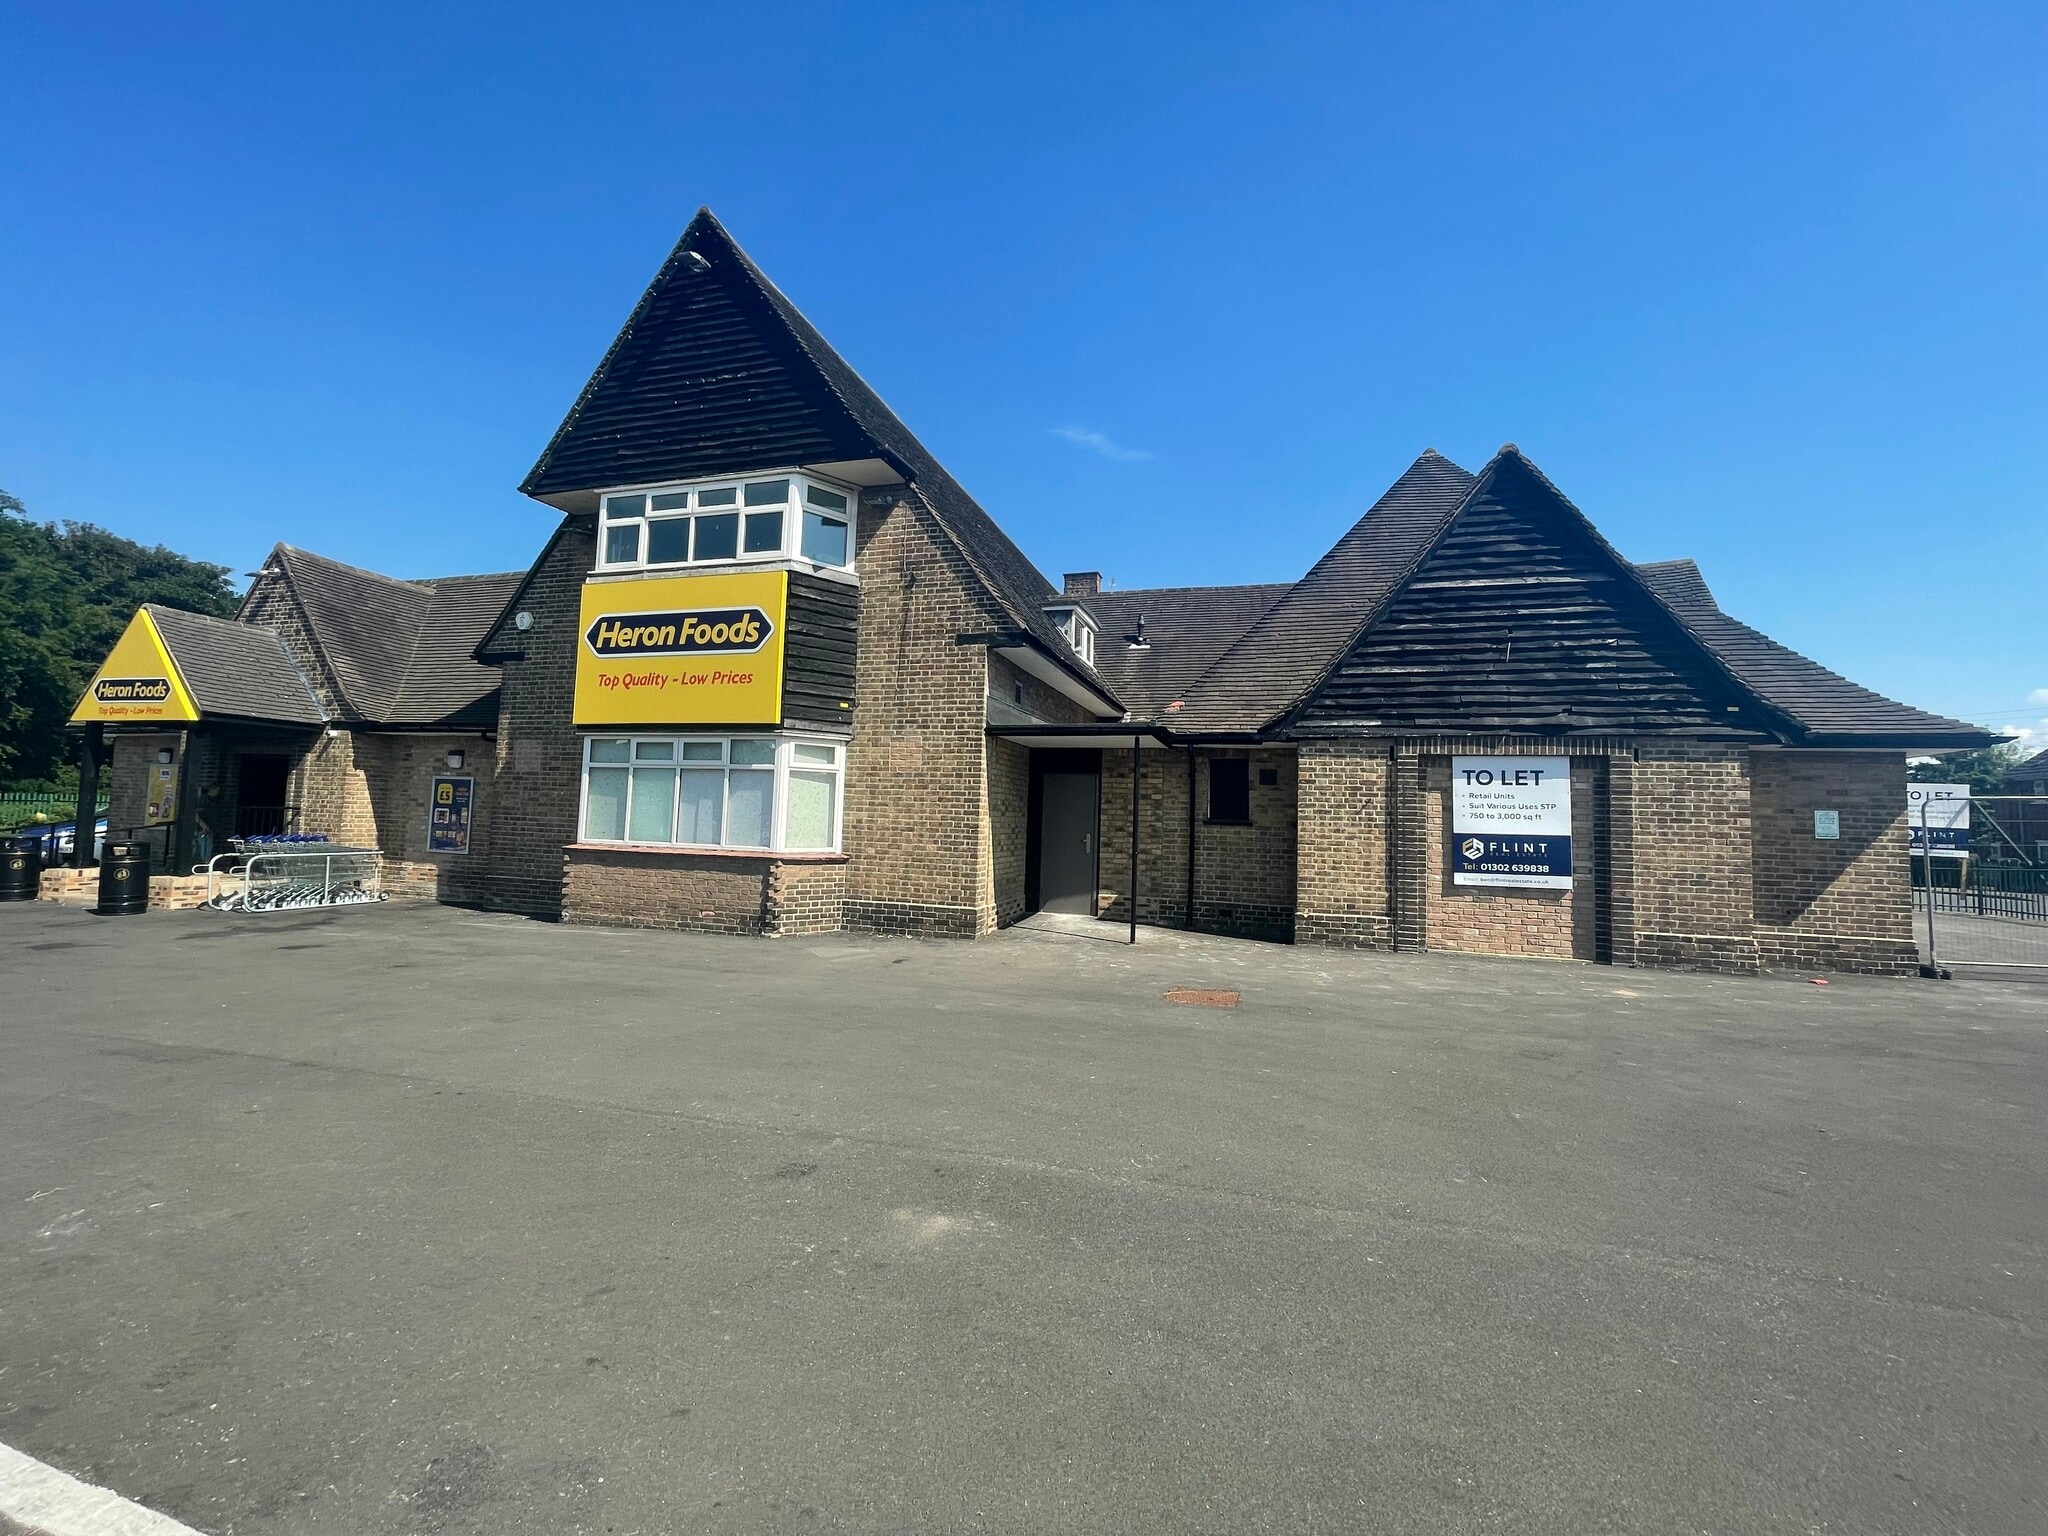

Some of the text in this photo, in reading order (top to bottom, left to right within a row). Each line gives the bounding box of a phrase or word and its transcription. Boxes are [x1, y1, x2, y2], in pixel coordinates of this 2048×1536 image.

[596, 613, 760, 648] Heron Foods
[598, 674, 620, 690] Top
[622, 672, 669, 690] Quality
[681, 672, 708, 686] Low
[711, 670, 753, 685] Prices
[98, 681, 167, 697] Heron Foods
[98, 707, 108, 716] Top
[109, 706, 129, 716] Quality
[133, 706, 145, 715] Low
[146, 706, 163, 715] Prices
[1462, 770, 1544, 785] TO LET
[440, 791, 450, 800] £5
[1905, 791, 1921, 800] O
[1496, 813, 1521, 821] 3,000
[1489, 842, 1548, 853] FLINT
[1480, 863, 1510, 871] 01302
[1511, 864, 1550, 873] 639838
